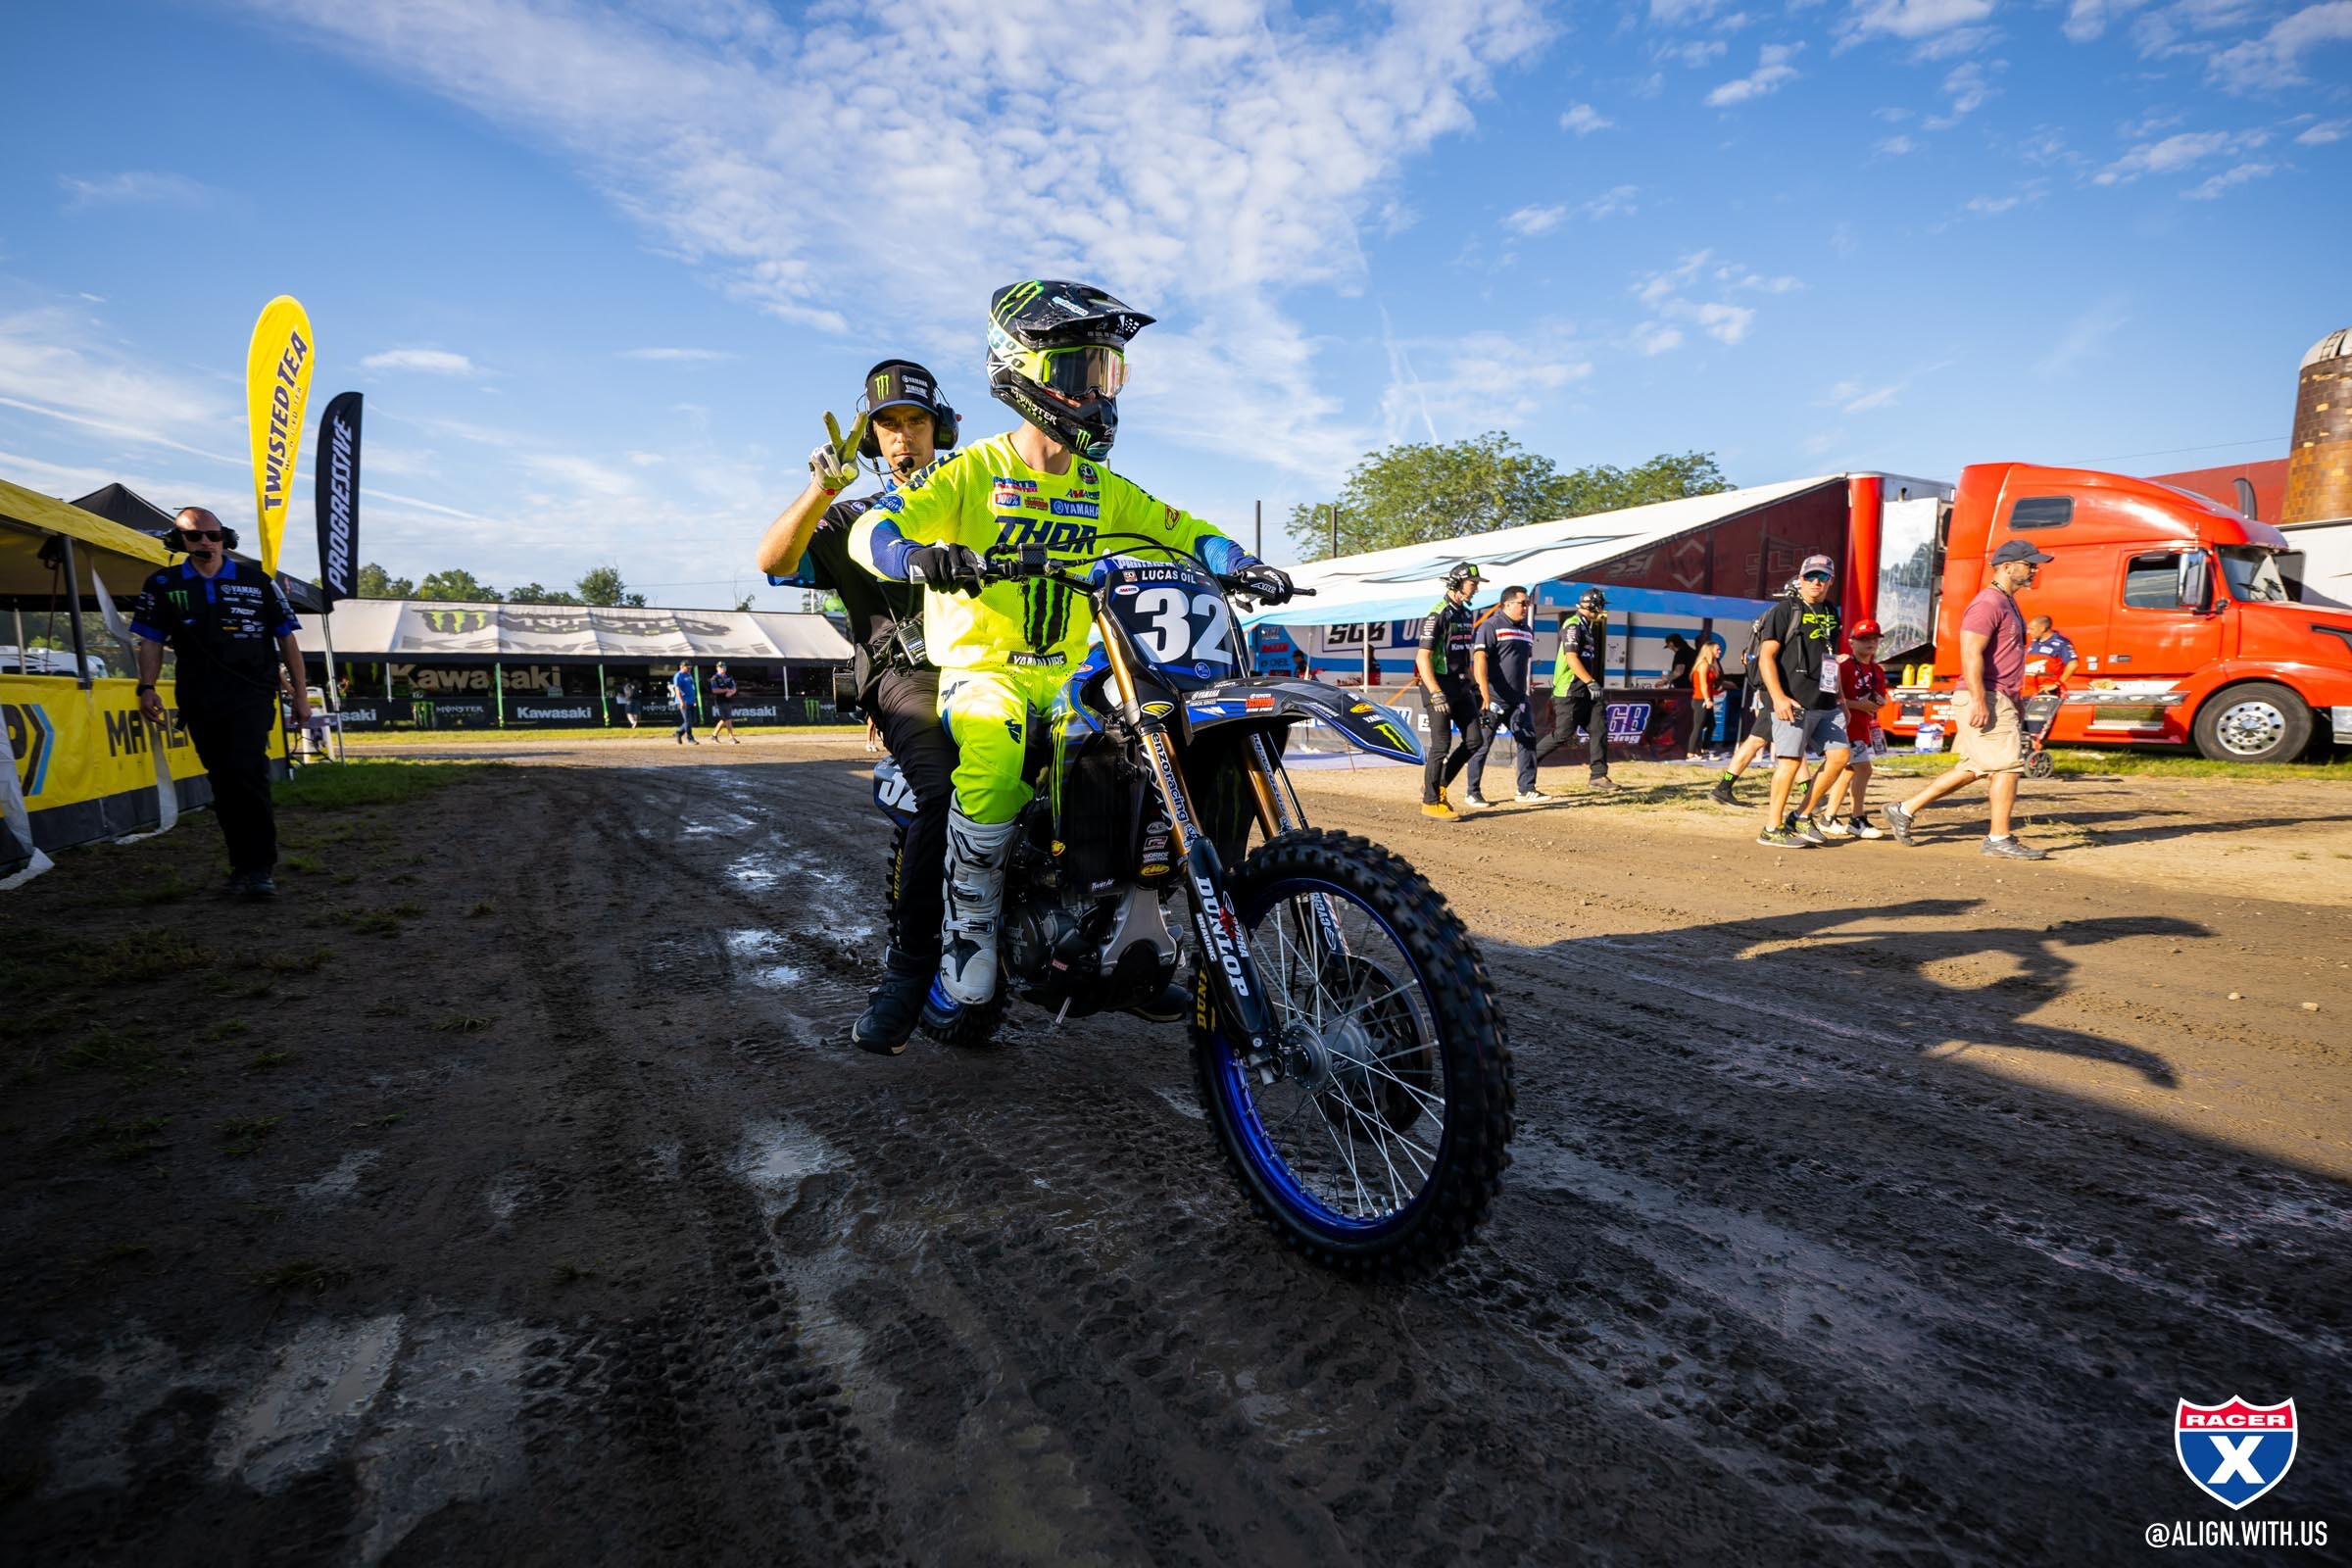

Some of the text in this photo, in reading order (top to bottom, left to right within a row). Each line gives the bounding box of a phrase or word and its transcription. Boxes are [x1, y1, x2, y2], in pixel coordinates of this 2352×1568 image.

[265, 330, 309, 511] TWISTED TEA
[1011, 386, 1057, 426] MONSTER
[328, 416, 353, 594] PROGRESSIVE
[998, 494, 1019, 506] 100%
[1063, 502, 1100, 517] YAMAHA
[995, 515, 1098, 556] THOR
[1142, 569, 1197, 584] LUCAS OIL
[1134, 587, 1233, 665] 32
[1328, 621, 1386, 645] SGB
[391, 663, 562, 690] Kawasaki
[341, 709, 376, 721] saki
[436, 705, 484, 713] MONSTER
[517, 707, 592, 719] Kawasaki
[712, 706, 776, 717] Kwasaki
[1577, 704, 1650, 736] GB
[1580, 734, 1641, 743] ring
[1152, 732, 1189, 822] enzoracing
[894, 848, 904, 900] DUNLOP
[1313, 892, 1331, 926] CYCR
[1196, 876, 1249, 997] DUNLOP
[1196, 912, 1218, 962] BRAKING
